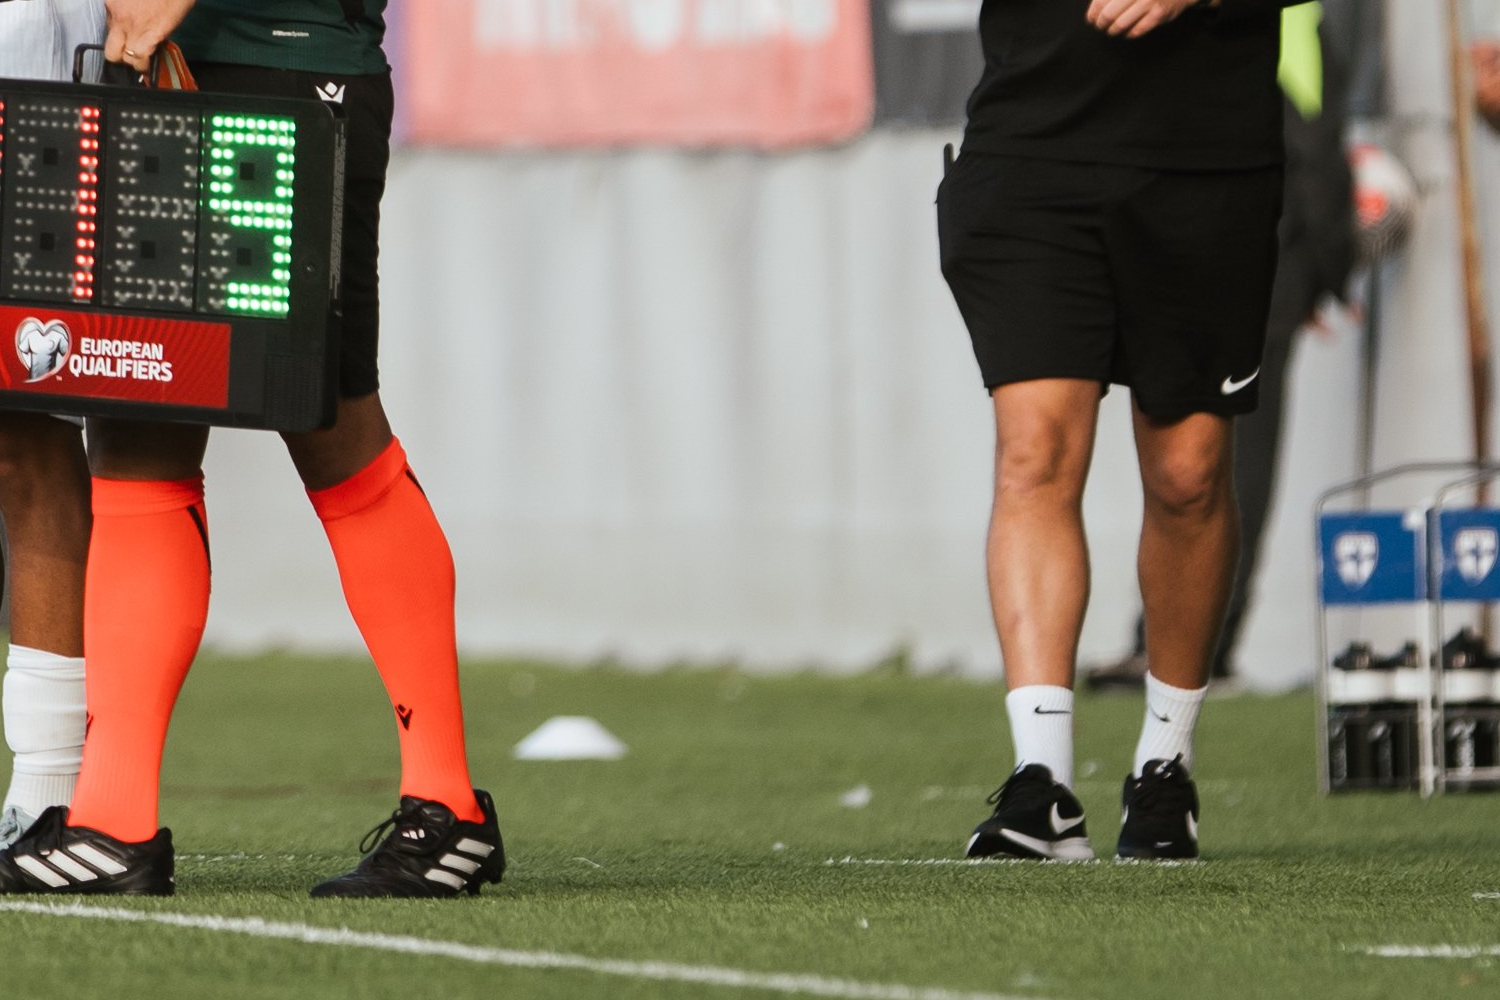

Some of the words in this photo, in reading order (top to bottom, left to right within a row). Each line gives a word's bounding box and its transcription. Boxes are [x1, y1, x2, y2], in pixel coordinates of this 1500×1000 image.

[210, 112, 297, 314] 9
[80, 337, 164, 361] EUROPEAN
[68, 354, 174, 382] QUALIFIERS
